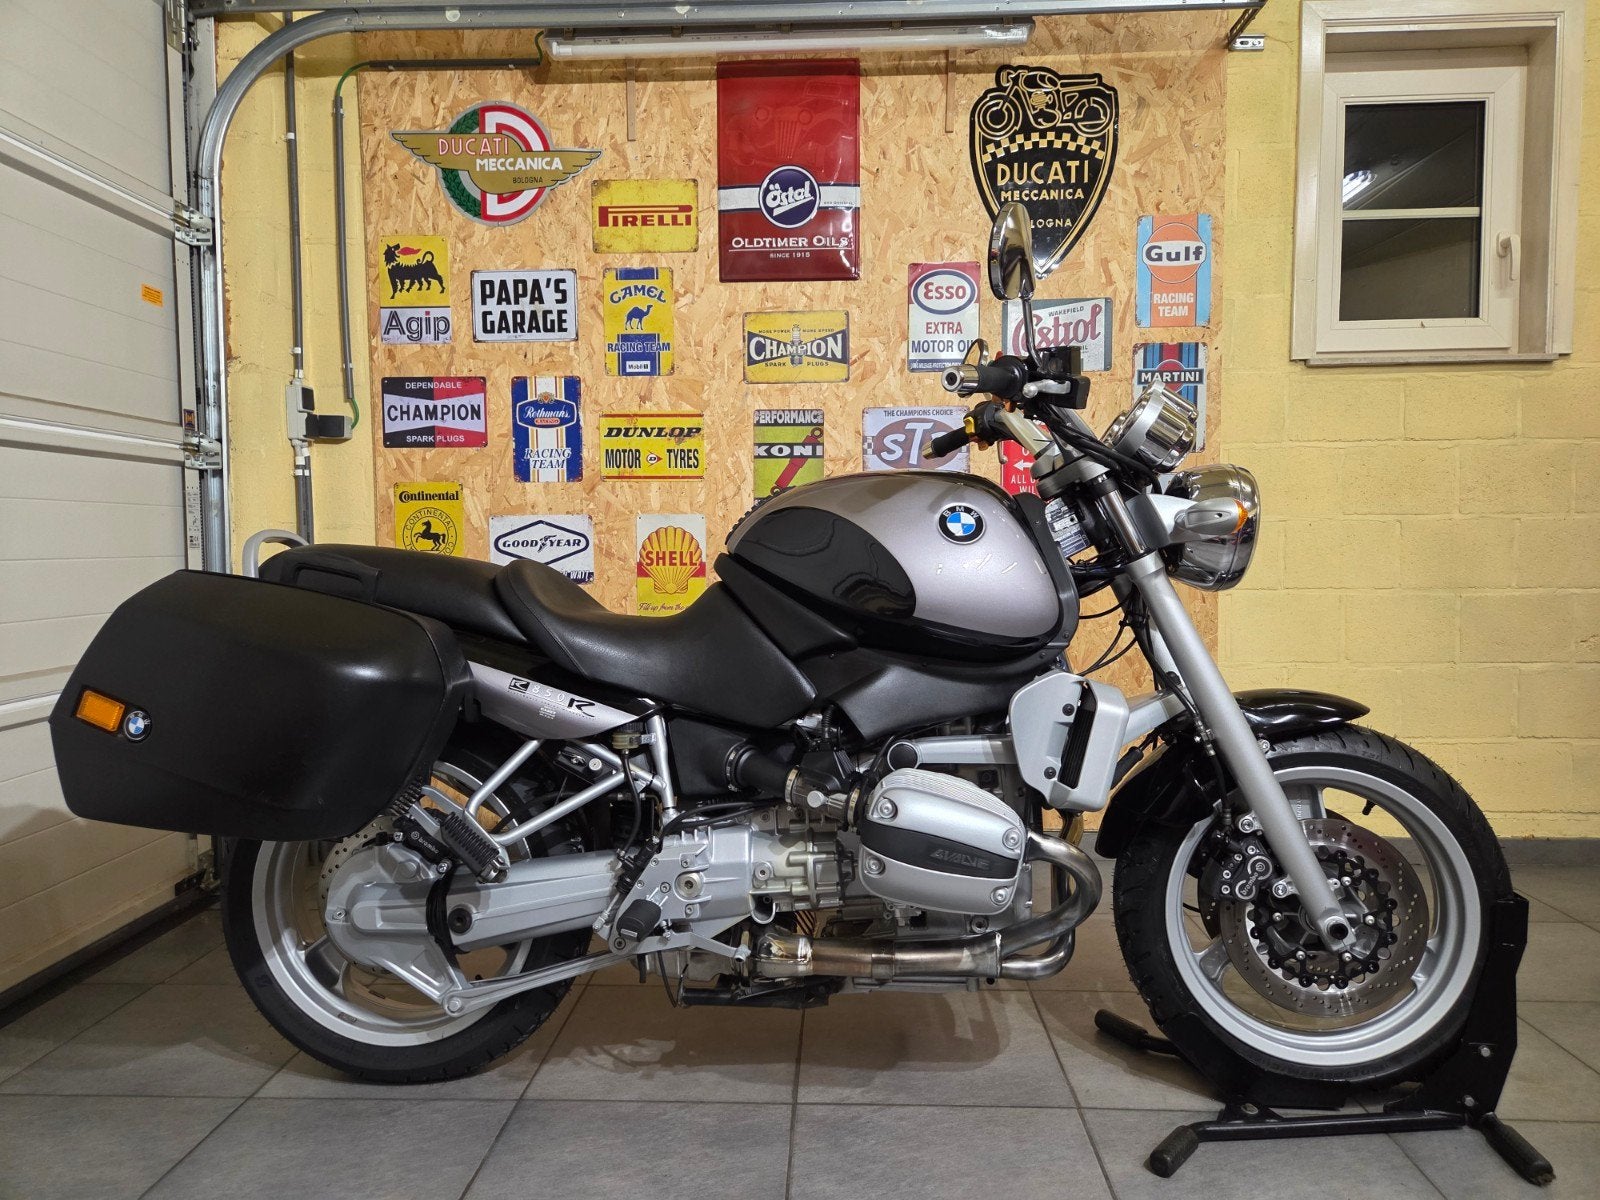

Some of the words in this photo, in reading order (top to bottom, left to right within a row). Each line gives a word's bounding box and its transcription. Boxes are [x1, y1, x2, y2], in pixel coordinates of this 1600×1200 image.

[439, 138, 508, 155] DUCATI
[476, 158, 563, 171] MECCANICA
[997, 160, 1088, 186] DUCATI
[1000, 188, 1085, 202] MECCANICA
[598, 205, 693, 227] PIRELLI
[1031, 218, 1072, 229] LOGNA
[731, 237, 808, 248] OLDTIMER
[1145, 245, 1203, 262] Gulf
[480, 278, 567, 305] PAPA'S
[609, 284, 666, 304] CAMEL
[1153, 293, 1193, 304] RACING
[1048, 306, 1084, 317] WAKEFIELD
[1158, 306, 1188, 317] TEAM
[383, 310, 450, 341] Agip
[482, 310, 568, 334] GARAGE
[925, 322, 963, 334] EXTRA
[607, 342, 642, 353] RACING
[645, 342, 671, 352] TEAM
[749, 333, 843, 361] CHAMPION
[911, 340, 954, 353] MOTOR
[1141, 372, 1199, 382] MARTINI
[387, 404, 481, 421] CHAMPION
[754, 410, 823, 424] PERFORMANCE
[897, 409, 931, 417] CHAMPIONS
[604, 427, 701, 437] DUNLOP
[524, 448, 571, 459] RACING
[754, 445, 823, 456] KONI
[532, 460, 565, 468] TEAM
[605, 449, 641, 468] MOTOR
[666, 449, 699, 468] TYRES
[1011, 475, 1026, 484] ALL
[398, 491, 459, 503] Continental
[942, 505, 980, 518] BMW
[406, 509, 453, 530] CONTINENTAL
[645, 550, 697, 566] SHELL
